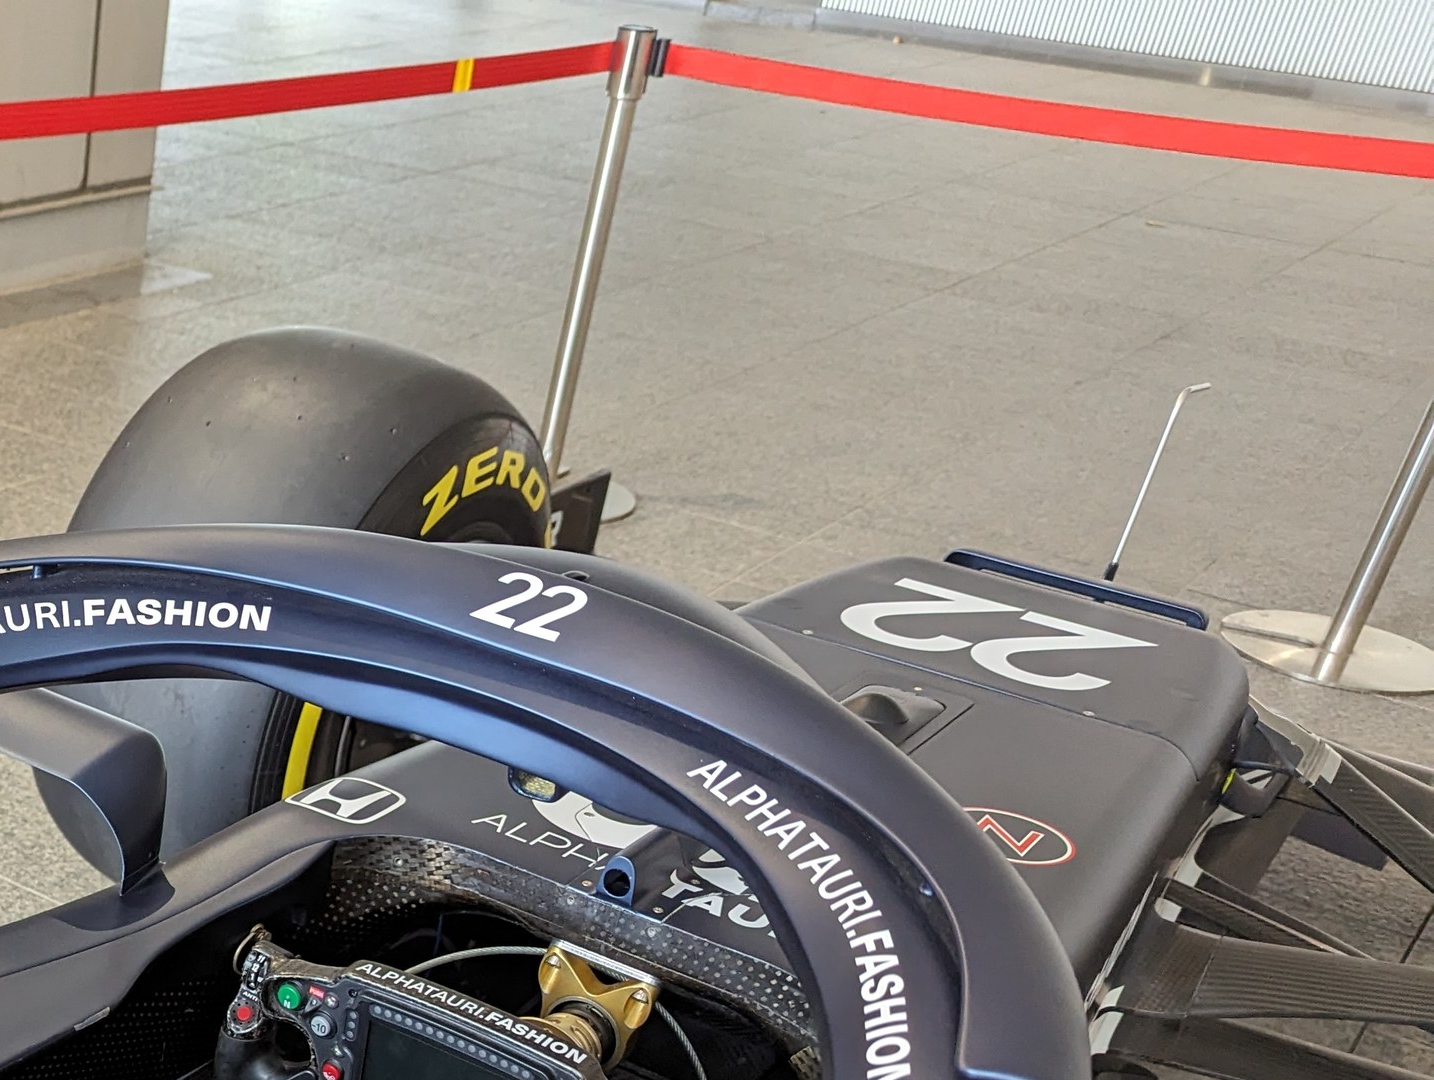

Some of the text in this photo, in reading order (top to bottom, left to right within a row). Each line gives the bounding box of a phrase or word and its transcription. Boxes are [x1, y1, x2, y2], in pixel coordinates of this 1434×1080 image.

[420, 446, 547, 537] ZERO
[469, 571, 588, 642] 22
[840, 577, 1159, 691] 22
[662, 868, 777, 939] TAU
[355, 963, 587, 1064] ALPHATAURI.FASHION
